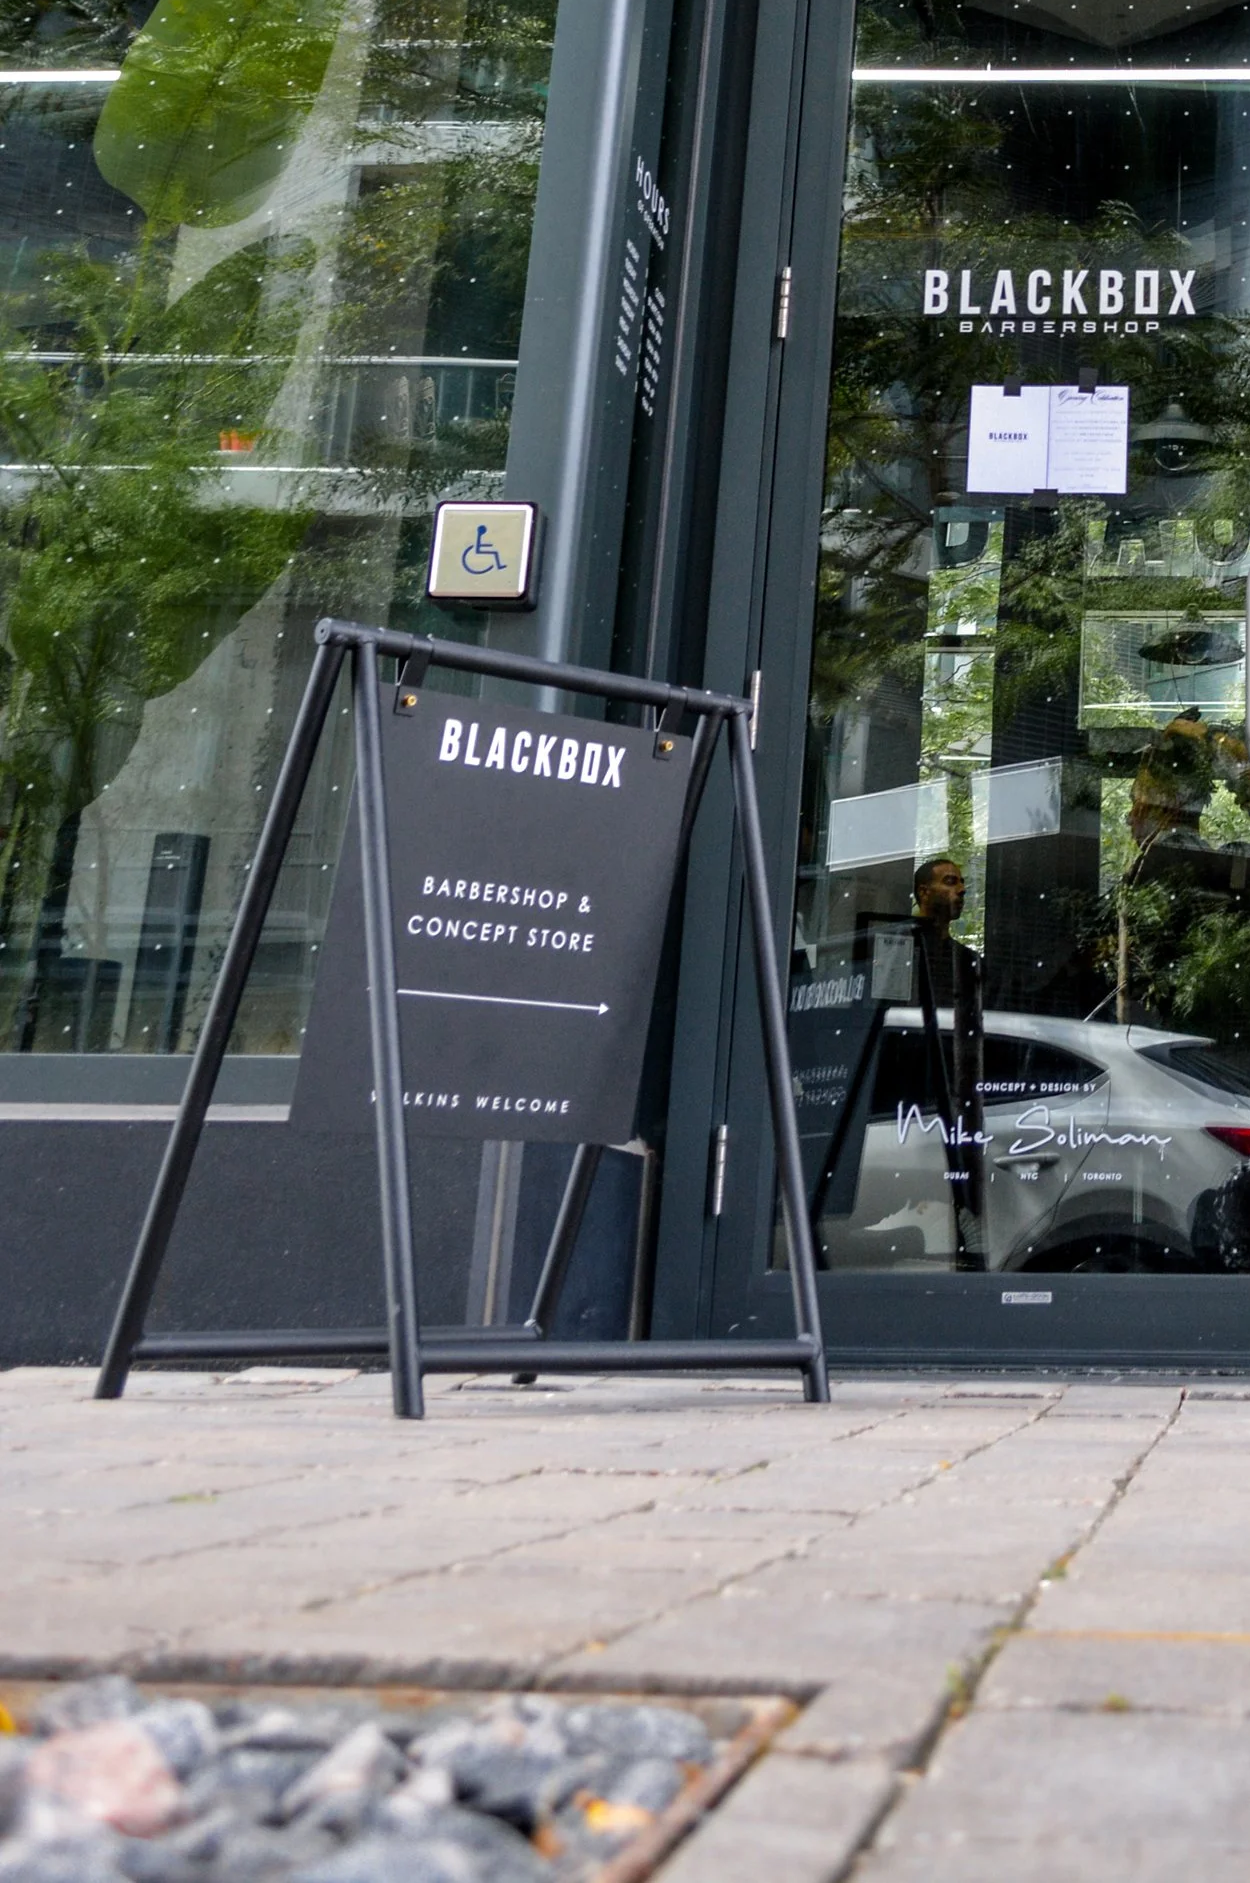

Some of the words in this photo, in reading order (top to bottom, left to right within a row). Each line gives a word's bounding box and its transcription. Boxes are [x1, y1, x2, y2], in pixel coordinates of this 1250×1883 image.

[635, 155, 670, 236] HOURS
[923, 269, 1196, 315] BLACKBOX
[959, 321, 1160, 333] BARBERSHOP
[988, 432, 1028, 441] BLACKBOX
[438, 718, 627, 788] BLACKBOX
[422, 875, 568, 910] BARBERSHOP
[577, 894, 592, 913] &
[407, 914, 518, 945] CONCEPT
[526, 927, 595, 953] STORE
[370, 1089, 460, 1108] LKINS
[475, 1095, 571, 1114] WELCOME
[975, 1082, 1026, 1092] CONCEPT
[1040, 1083, 1079, 1092] DESIGN
[1083, 1083, 1096, 1092] BY
[897, 1100, 994, 1150] Mike
[1082, 1172, 1123, 1181] TORONTO
